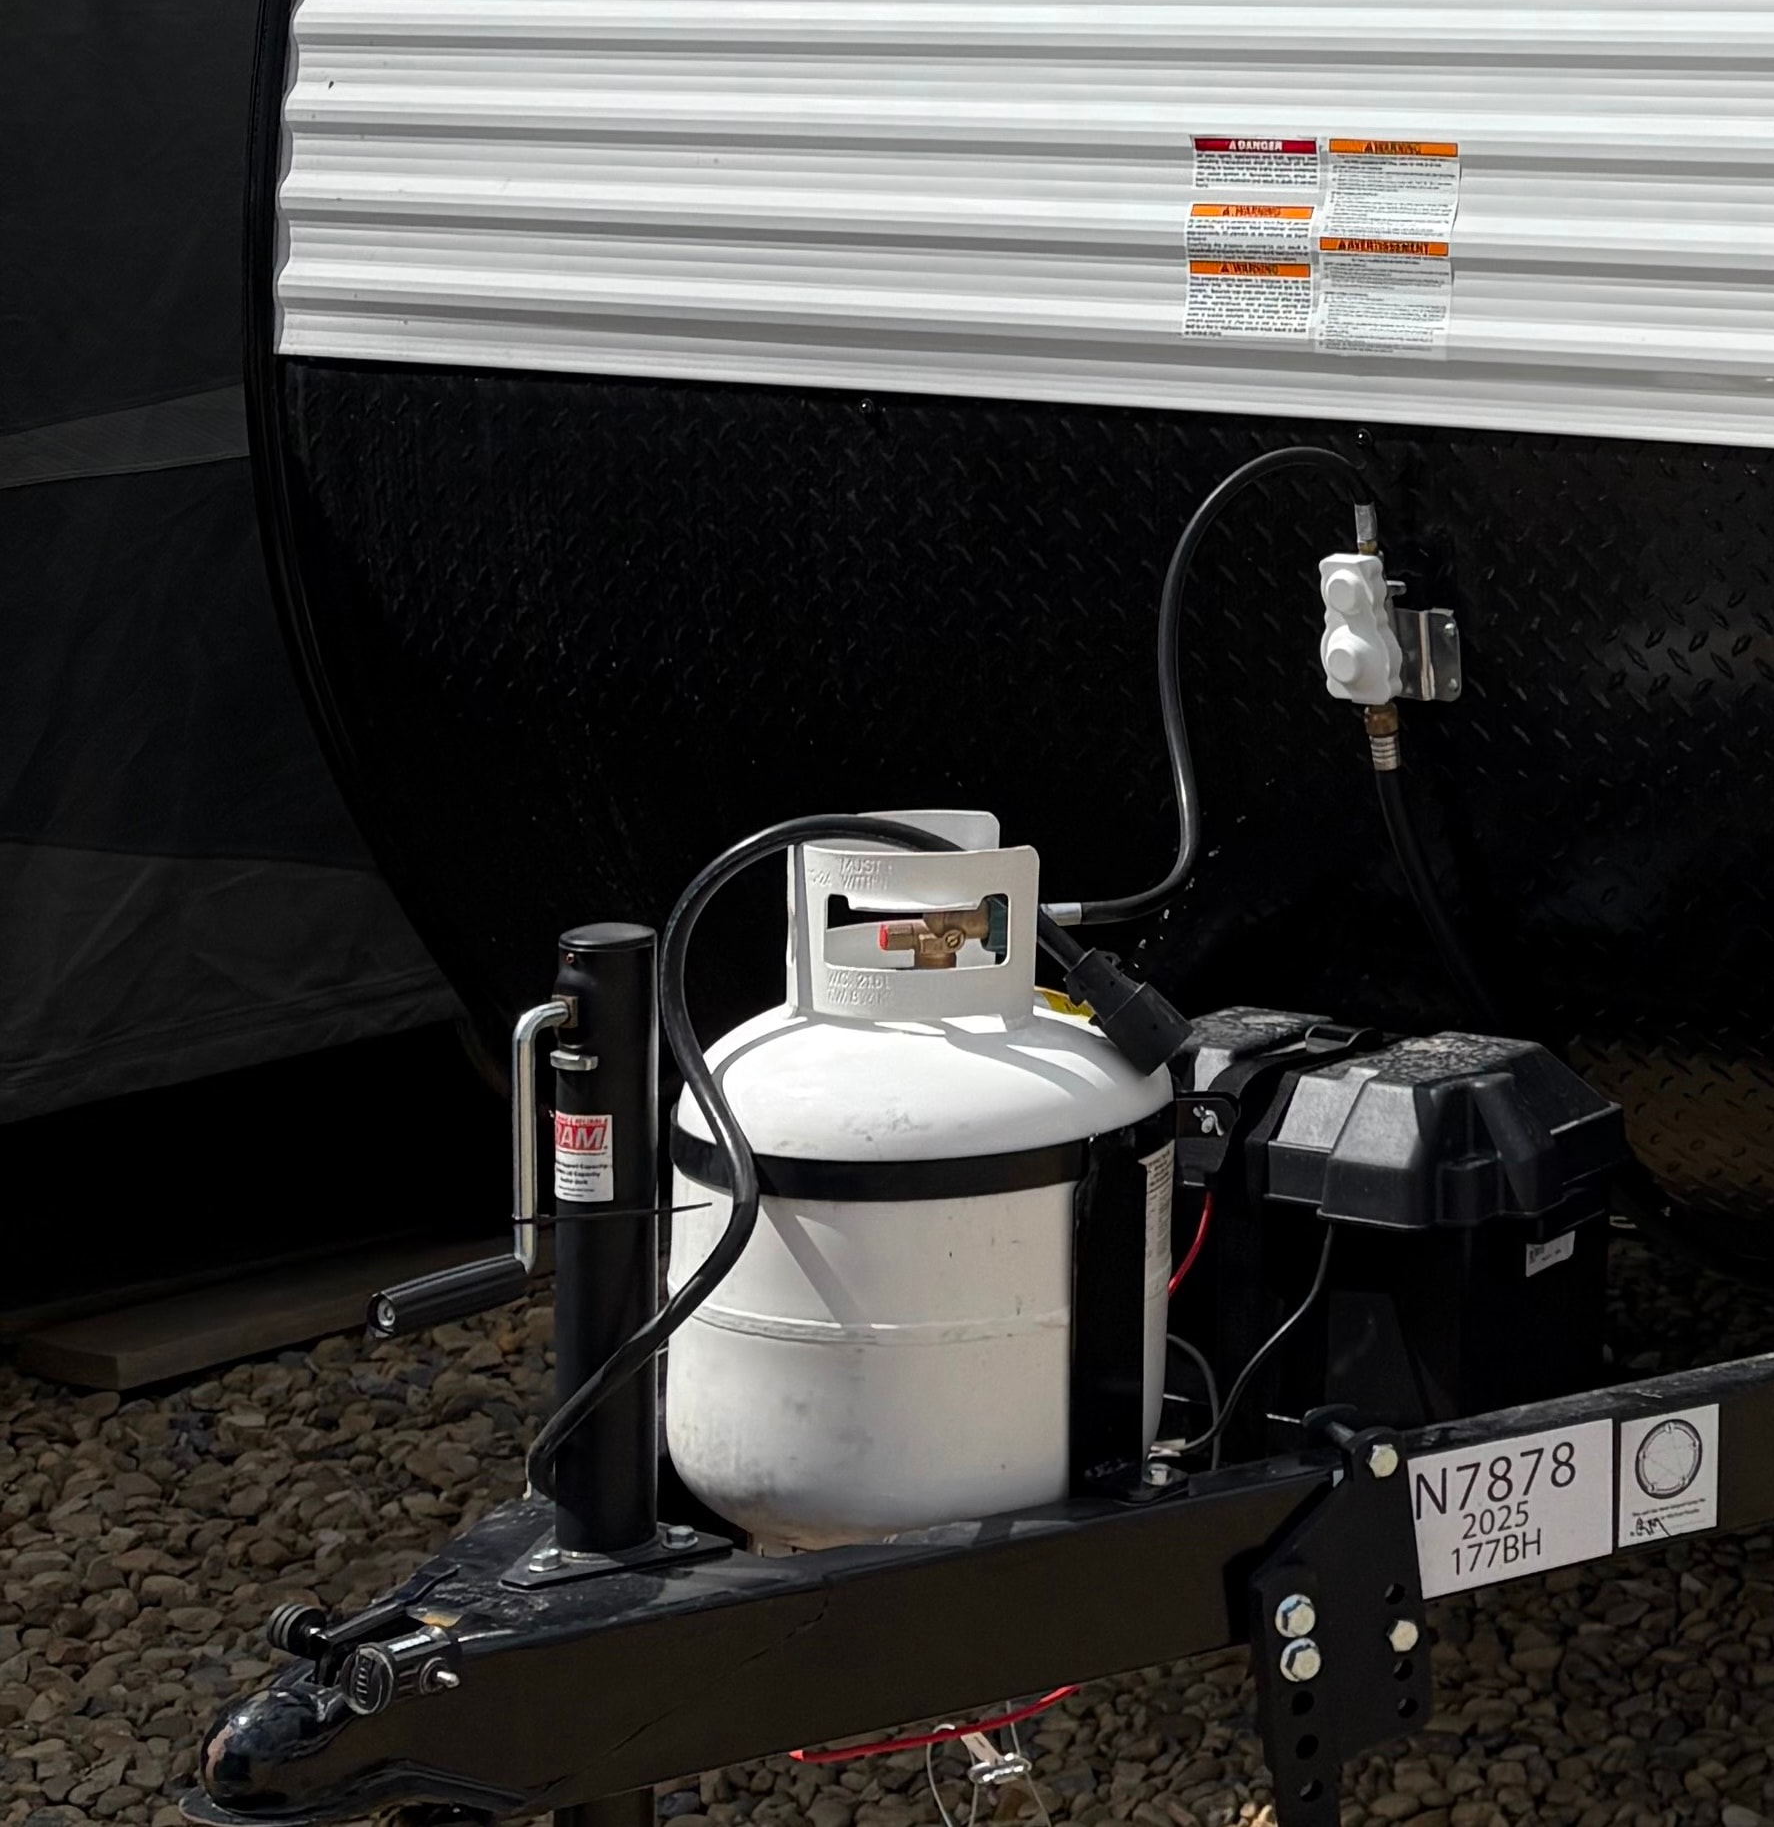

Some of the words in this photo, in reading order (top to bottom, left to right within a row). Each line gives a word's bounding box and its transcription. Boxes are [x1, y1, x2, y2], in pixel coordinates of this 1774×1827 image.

[1236, 139, 1283, 152] DANGER
[1231, 262, 1278, 276] WARNING
[1415, 1441, 1577, 1521] N7878
[1462, 1500, 1530, 1540] 2025
[1451, 1528, 1542, 1576] 177BH
